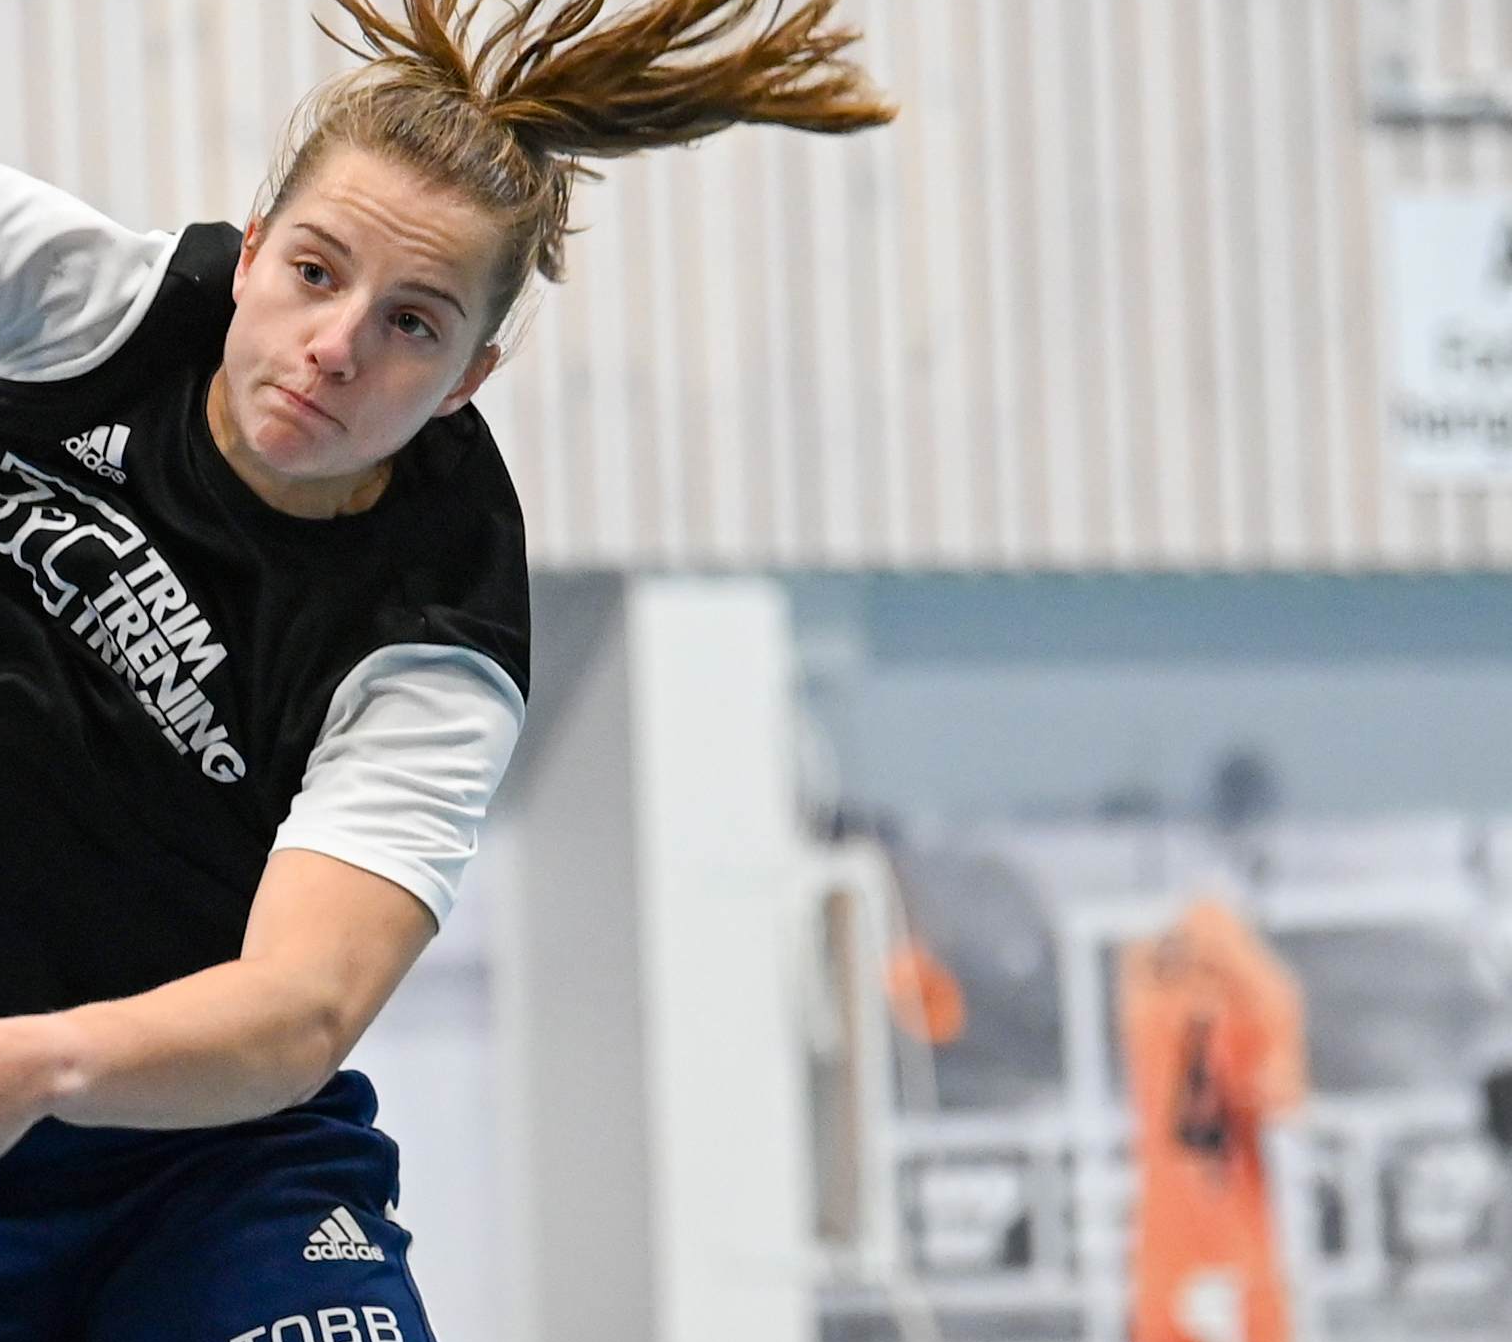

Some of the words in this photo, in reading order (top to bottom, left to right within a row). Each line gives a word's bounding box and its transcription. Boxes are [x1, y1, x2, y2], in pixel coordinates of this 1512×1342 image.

[92, 570, 247, 784] TRENING
[125, 546, 228, 685] TRIM
[302, 1241, 385, 1262] adidas
